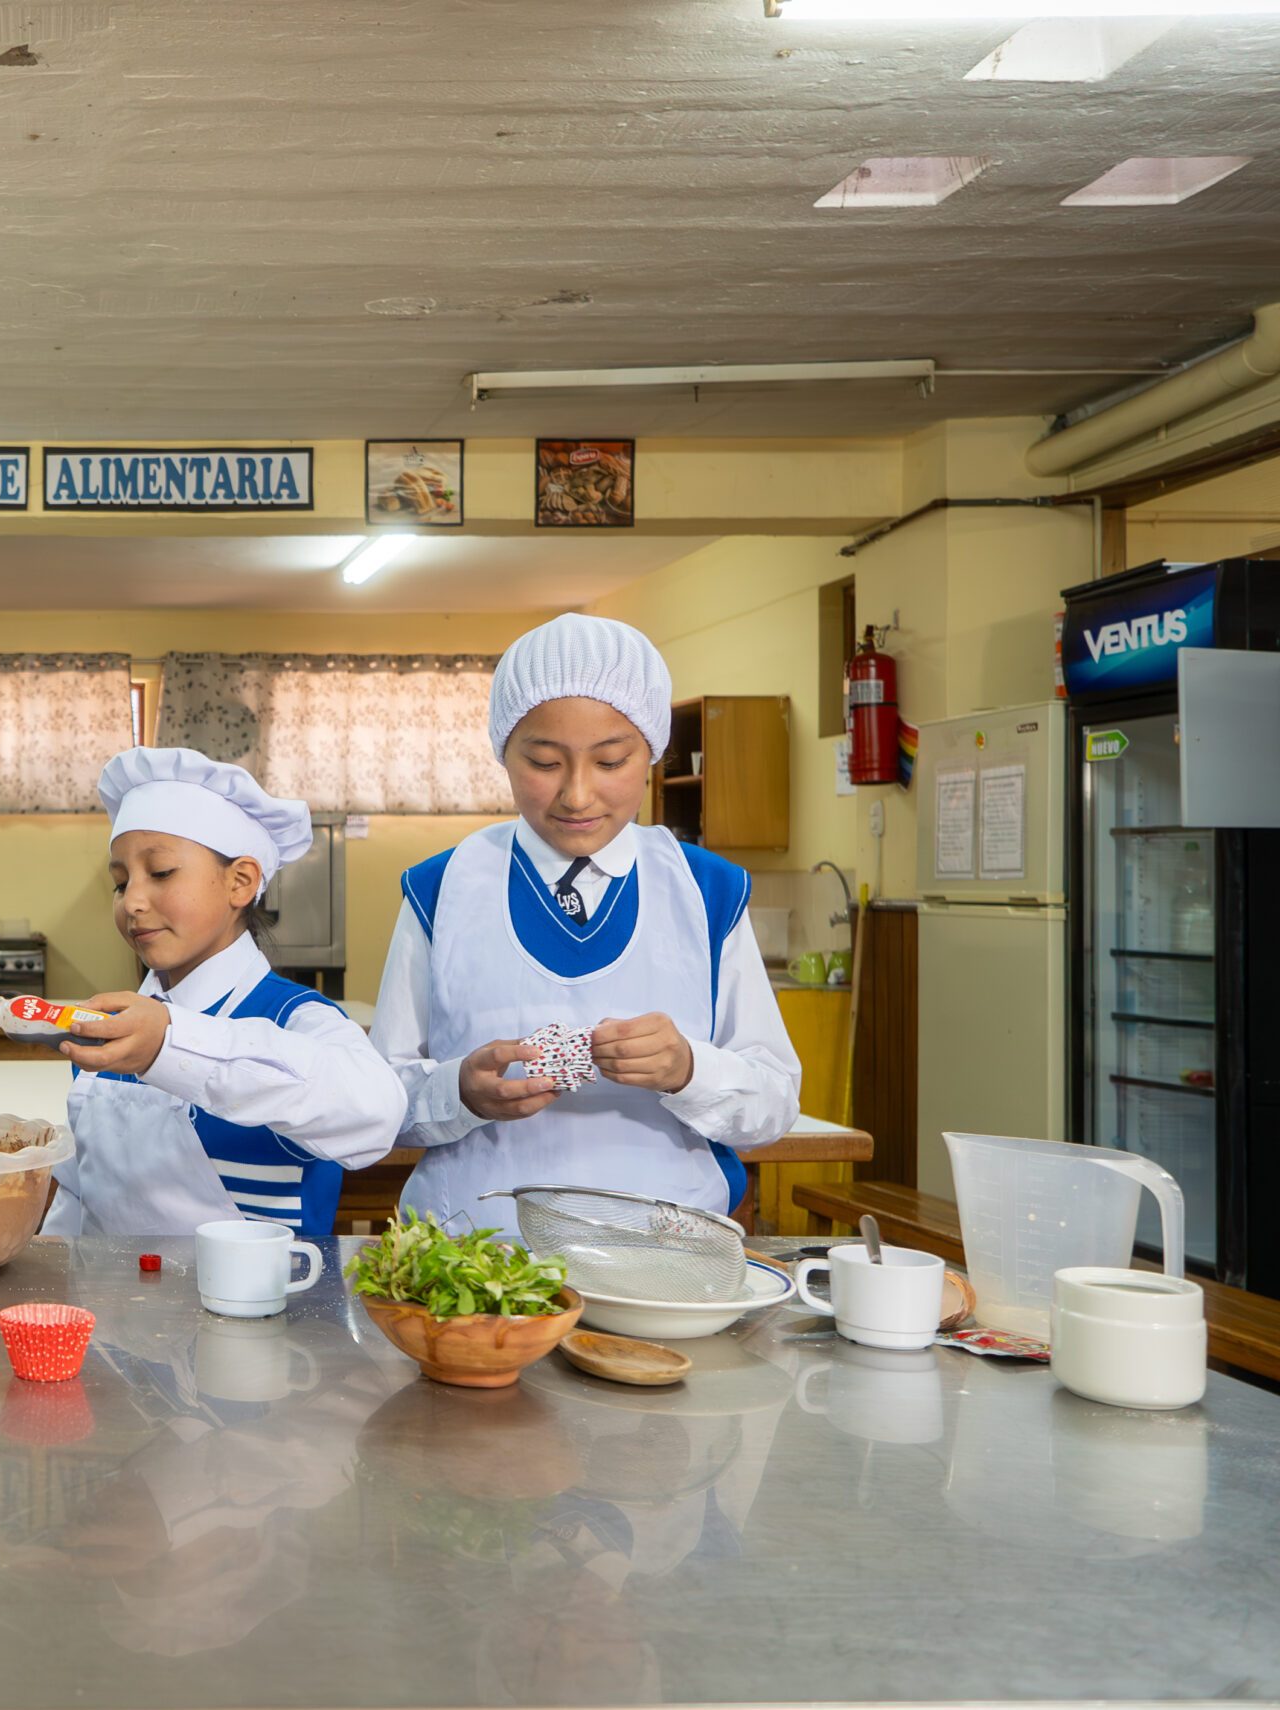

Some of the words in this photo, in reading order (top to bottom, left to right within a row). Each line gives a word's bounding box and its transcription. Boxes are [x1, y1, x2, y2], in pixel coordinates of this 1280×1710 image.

[53, 456, 300, 501] ALIMENTARIA
[1082, 608, 1188, 664] VENTUS
[1092, 740, 1120, 756] NUEVO
[556, 892, 579, 910] LVS
